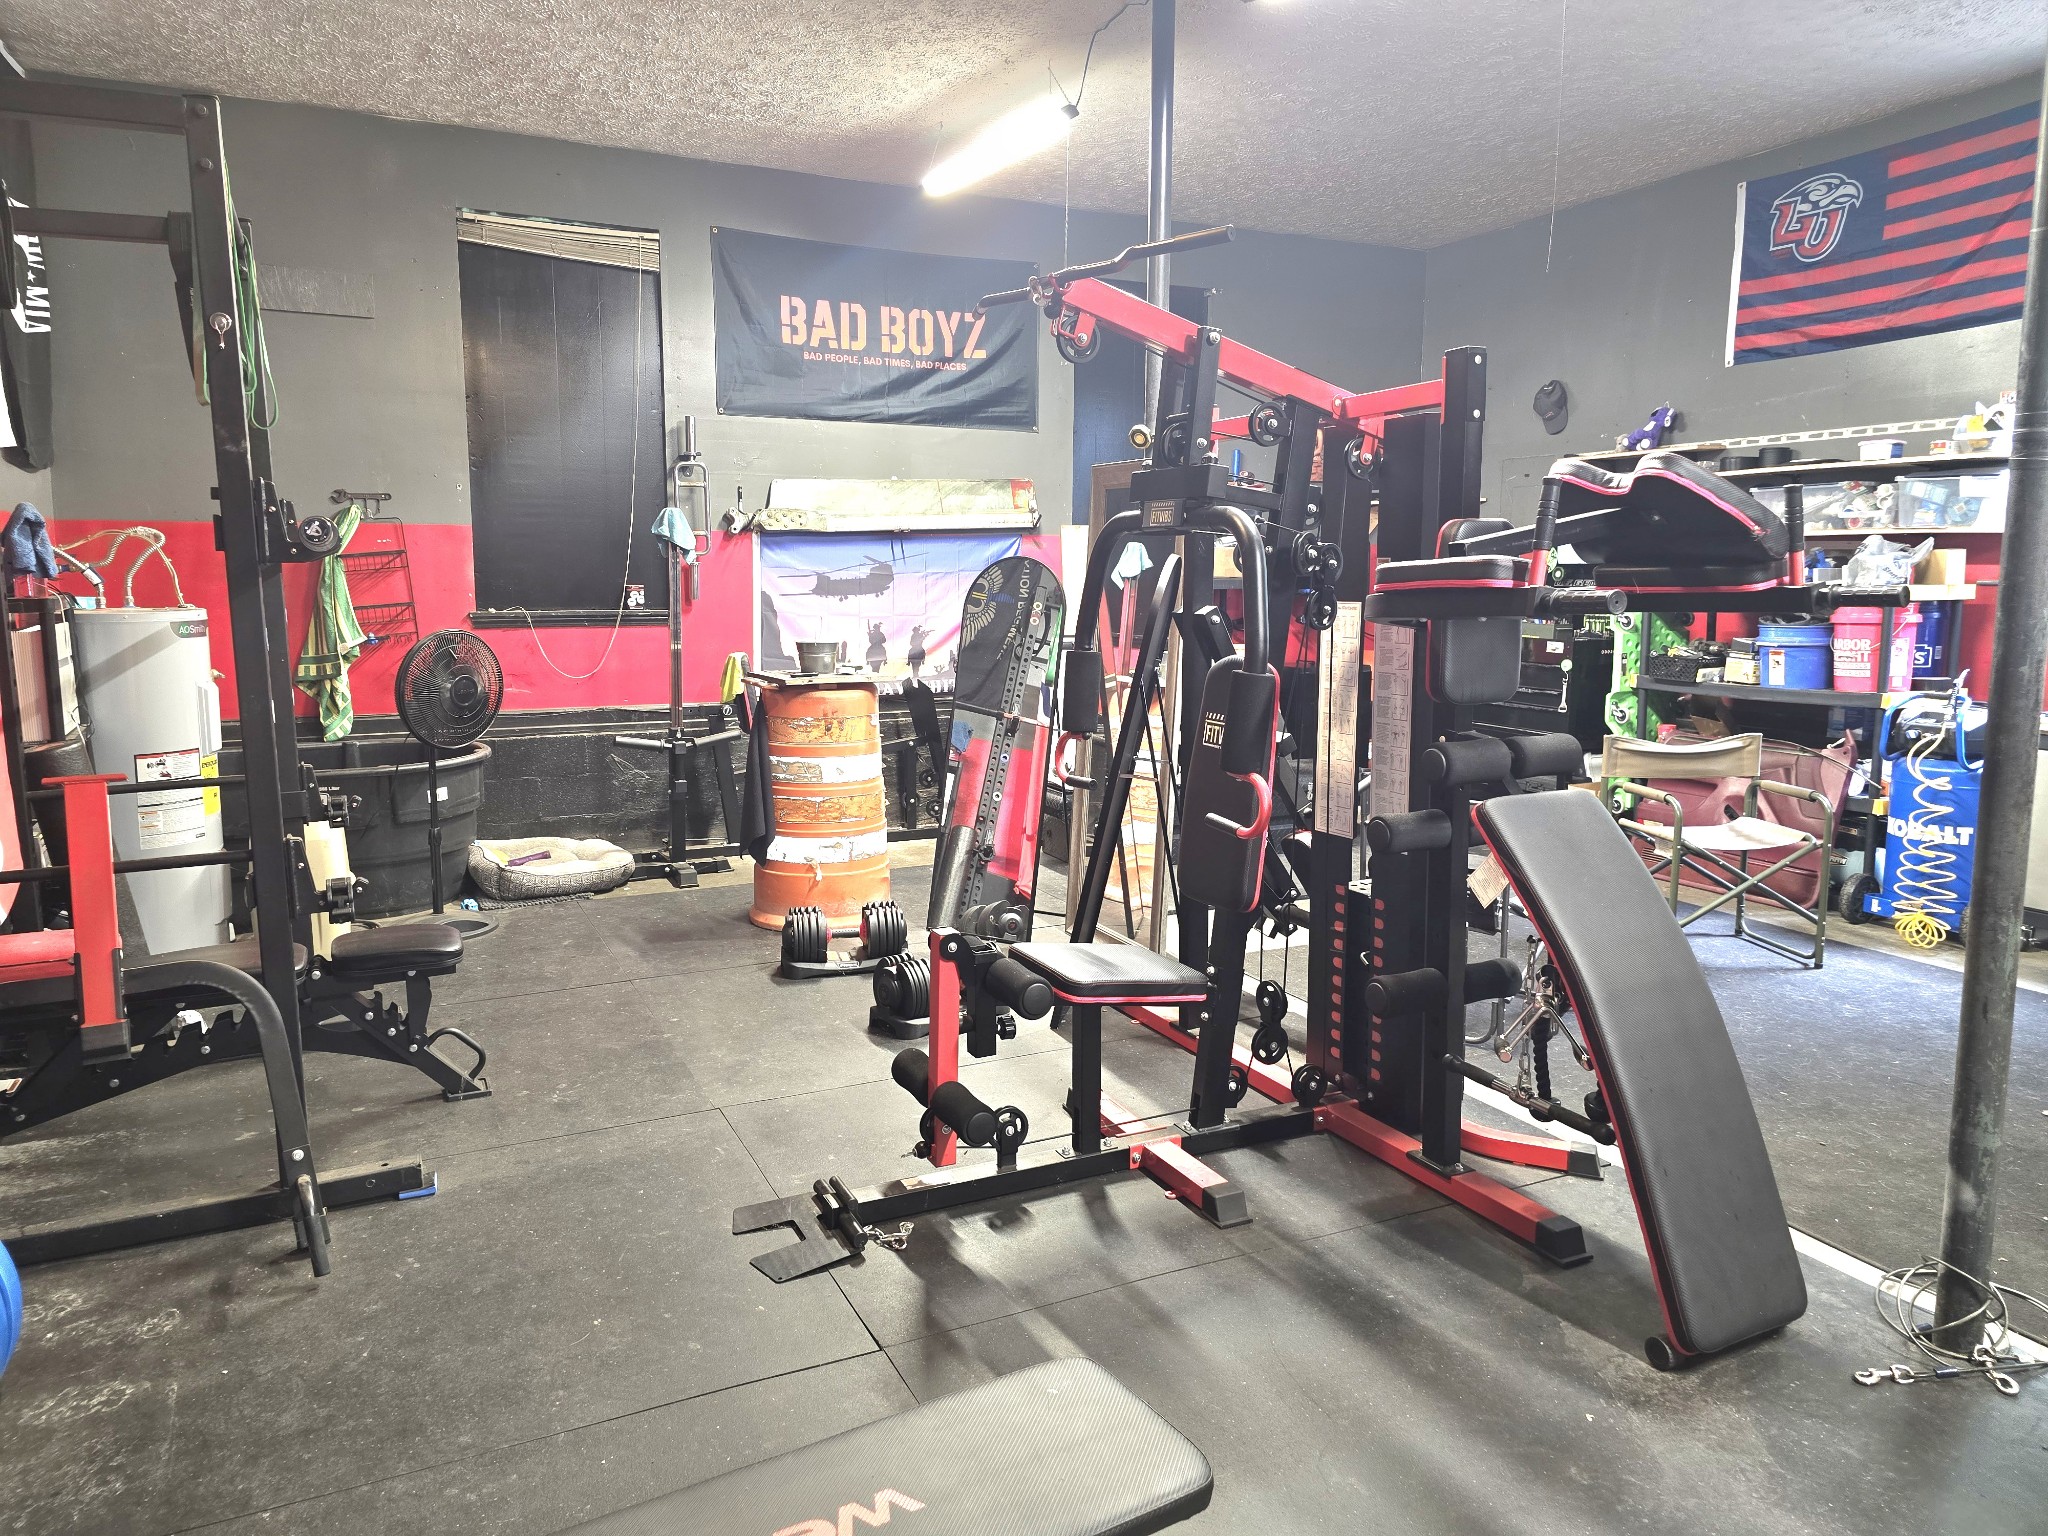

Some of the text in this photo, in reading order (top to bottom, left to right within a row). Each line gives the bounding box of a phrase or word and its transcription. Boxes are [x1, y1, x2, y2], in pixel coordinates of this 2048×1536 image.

[1770, 197, 1849, 262] LU
[780, 294, 987, 359] BAD BOYZ
[803, 352, 967, 371] BAD PEOPLE, BAD TIMES, BAD PLACES
[1887, 815, 1974, 846] KOBALT
